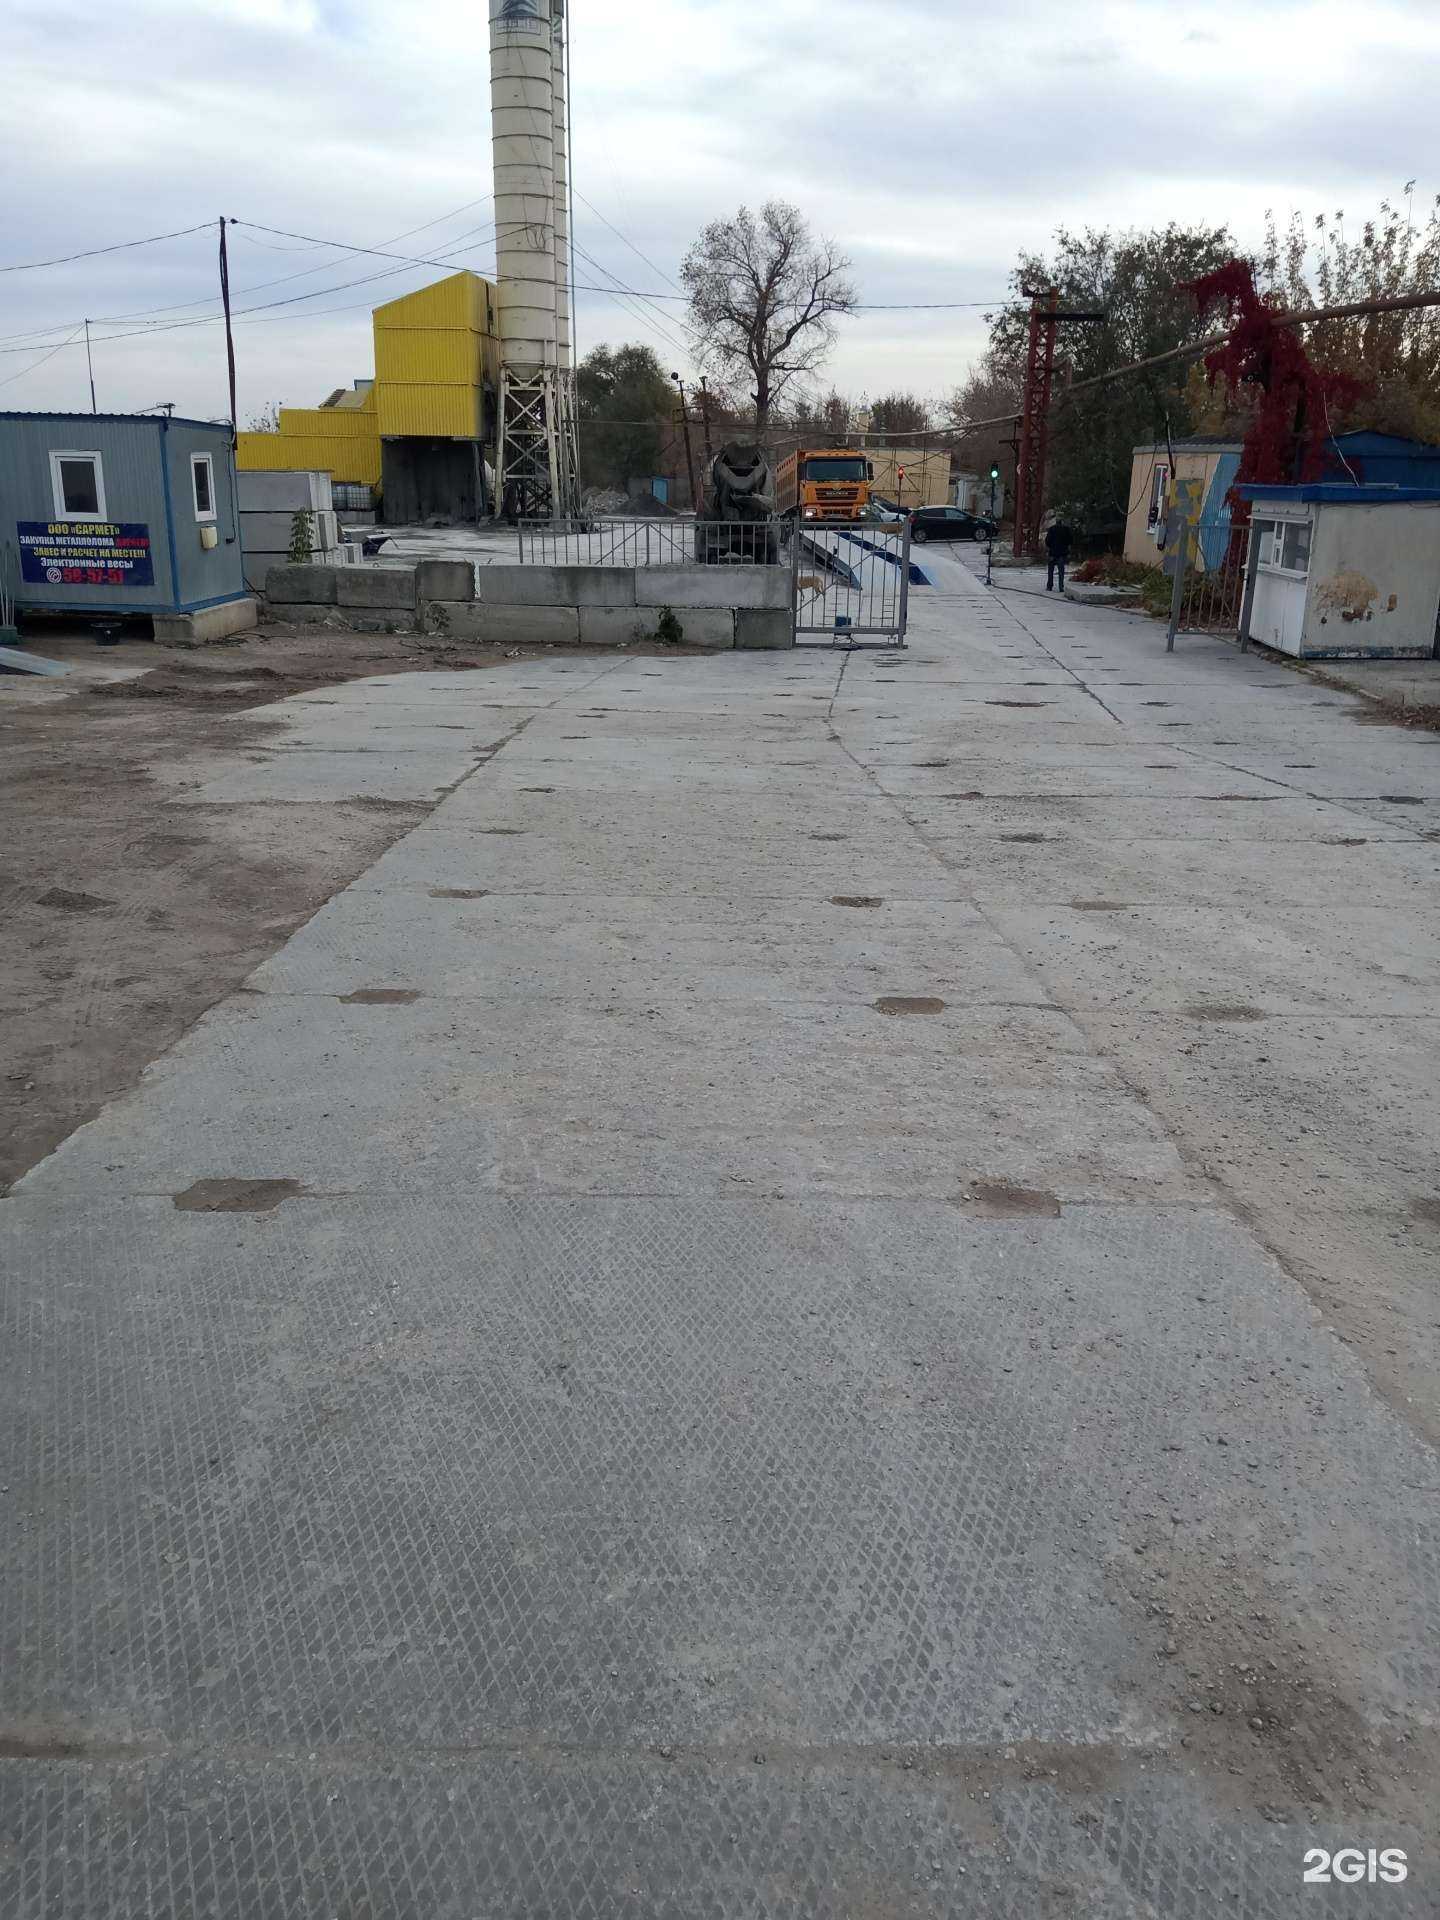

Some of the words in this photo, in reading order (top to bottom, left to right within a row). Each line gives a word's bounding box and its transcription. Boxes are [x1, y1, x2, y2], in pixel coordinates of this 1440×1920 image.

[48, 524, 69, 534] ООО
[20, 536, 55, 545] ЗАКУПКА
[55, 537, 114, 546] МЕТАЛЛОЛОМА
[99, 549, 111, 558] НА
[40, 558, 105, 568] Электронные
[107, 560, 133, 569] весы
